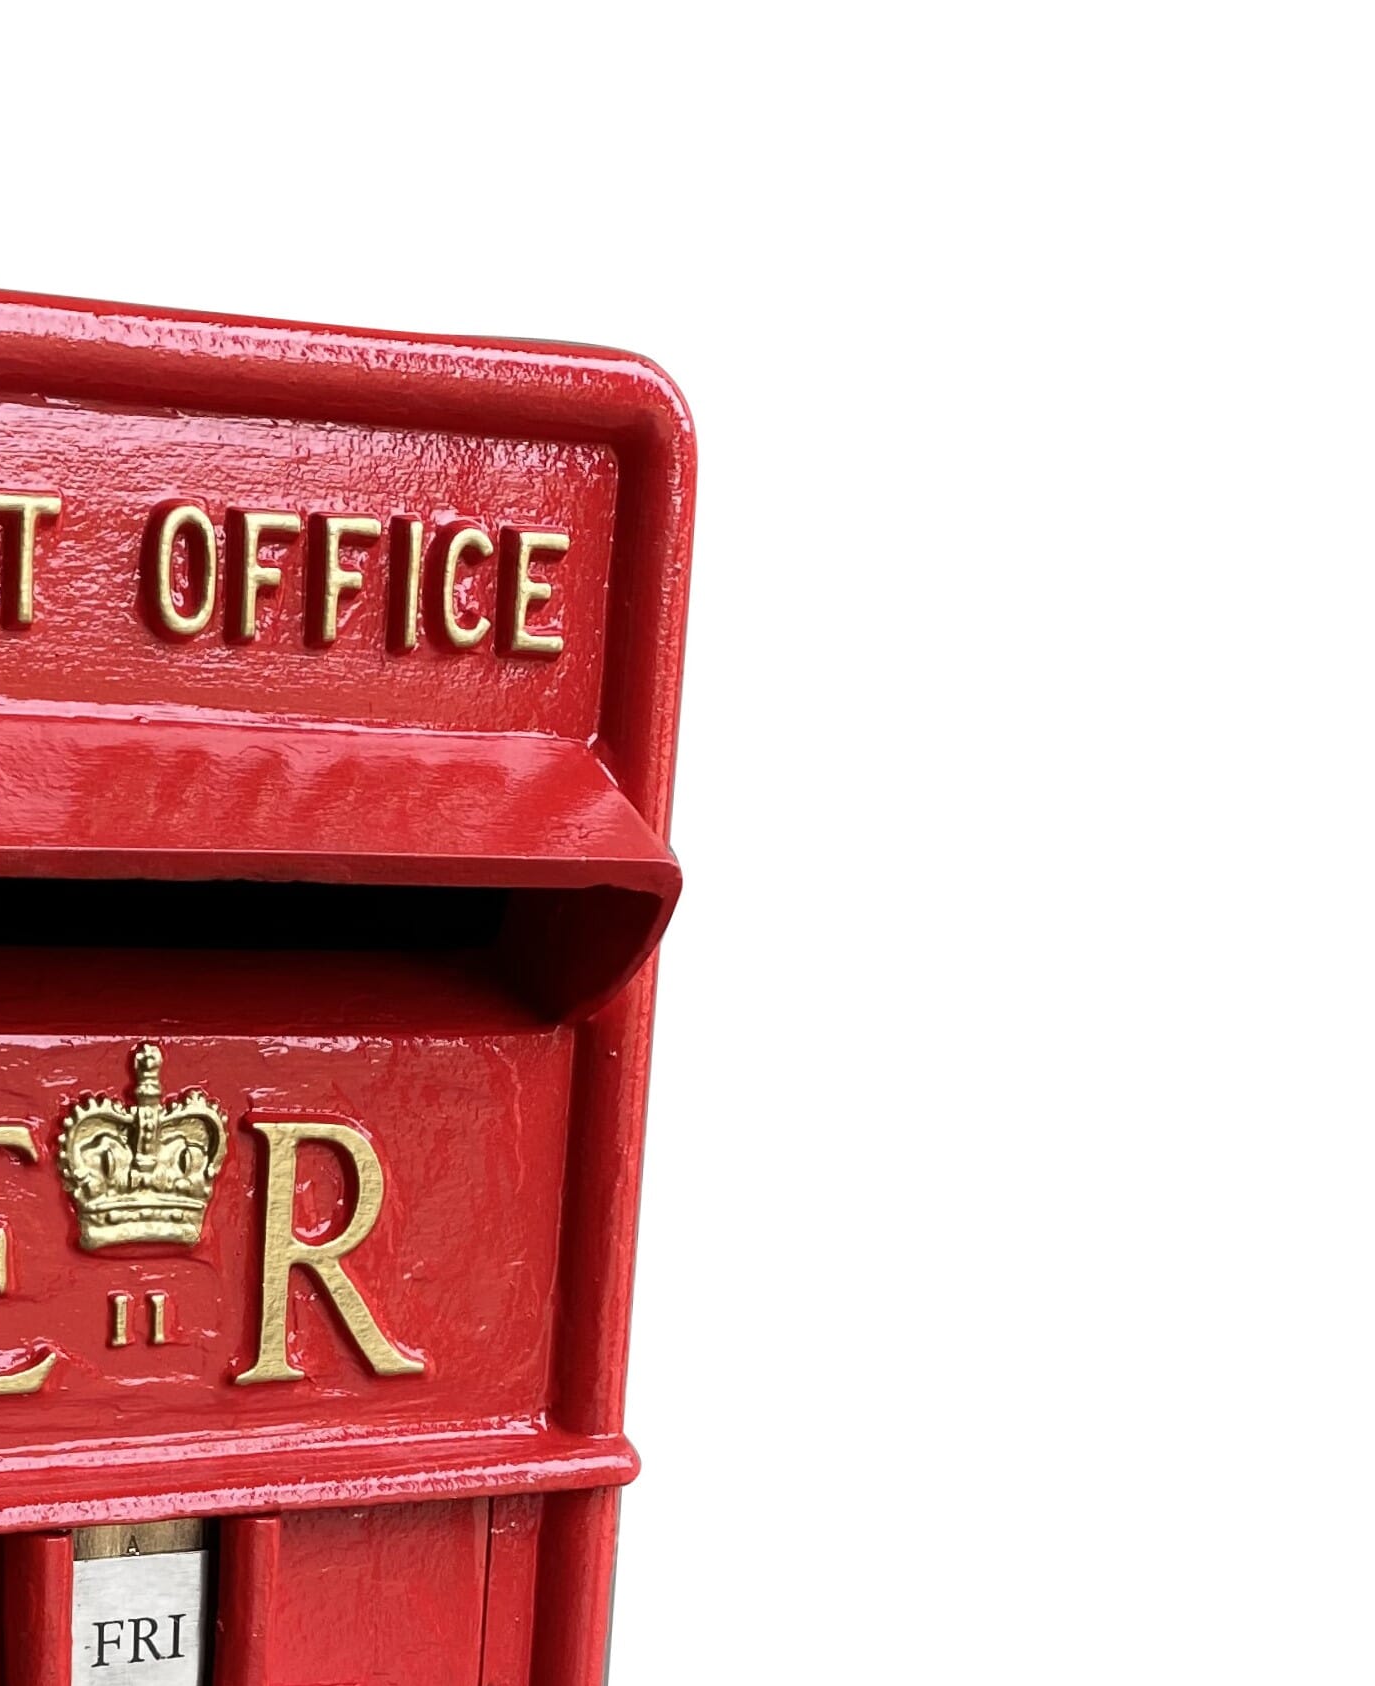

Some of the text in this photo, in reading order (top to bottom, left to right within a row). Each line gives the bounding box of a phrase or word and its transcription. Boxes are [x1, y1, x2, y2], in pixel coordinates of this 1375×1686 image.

[155, 502, 572, 656] OFFICE
[234, 1120, 427, 1387] R
[90, 1612, 186, 1668] FRI
